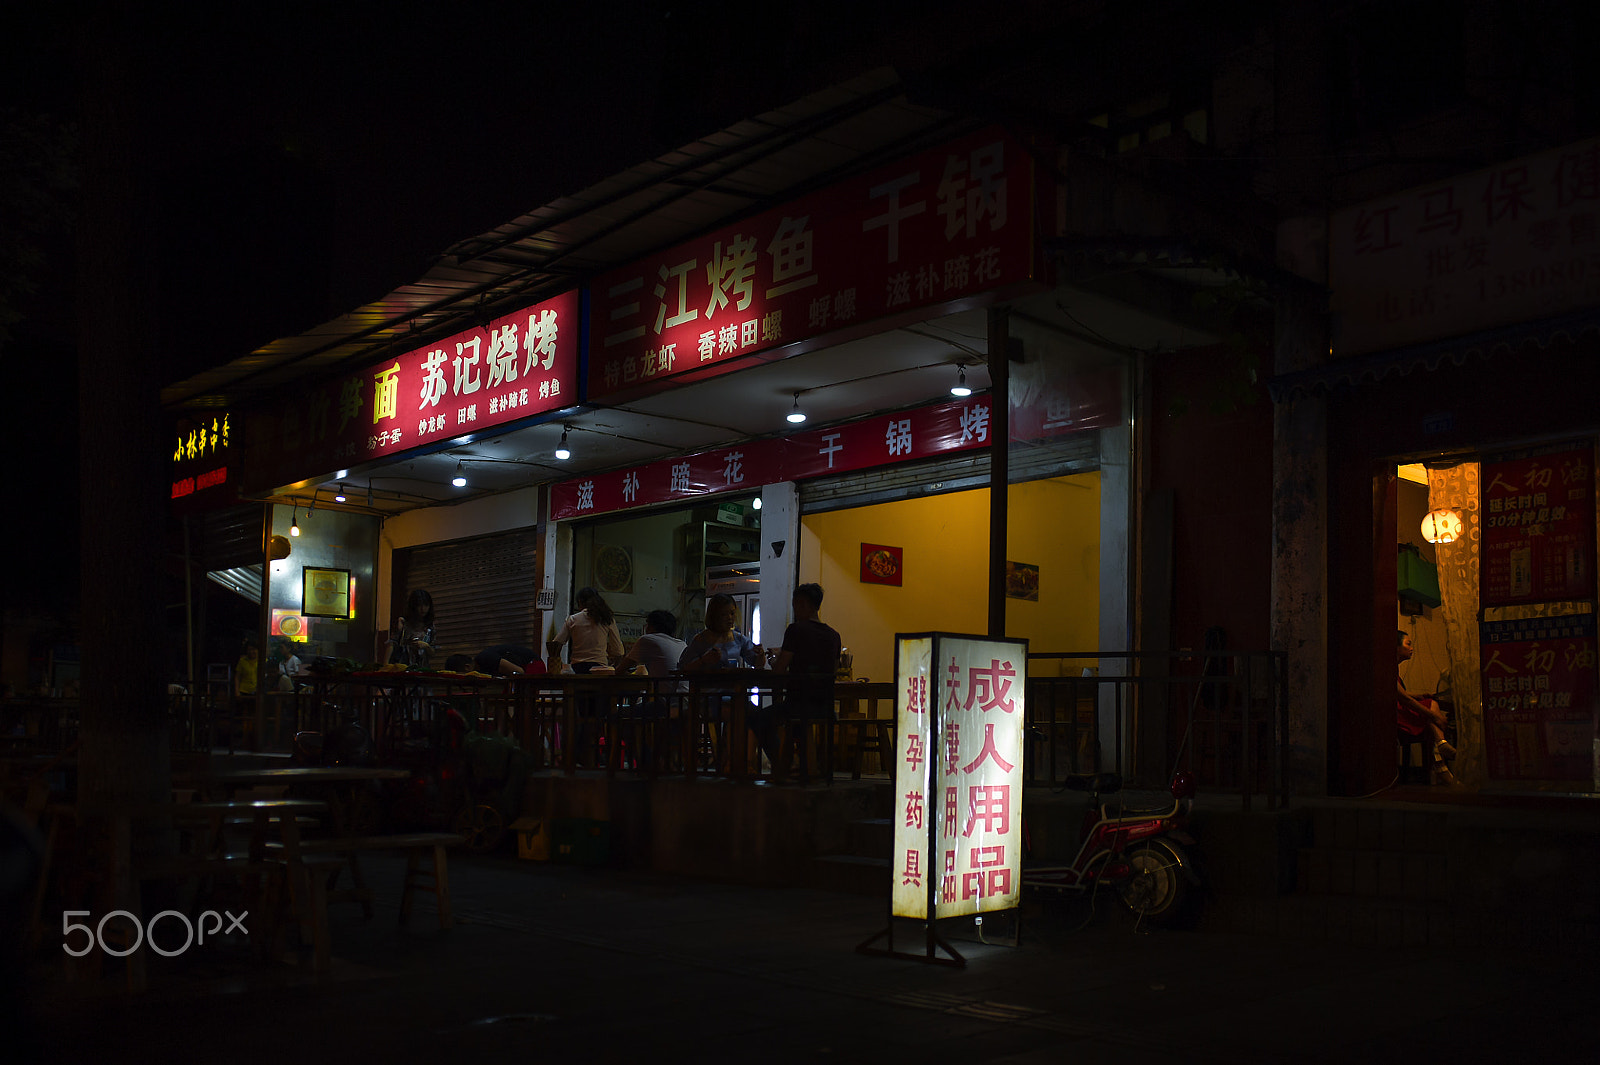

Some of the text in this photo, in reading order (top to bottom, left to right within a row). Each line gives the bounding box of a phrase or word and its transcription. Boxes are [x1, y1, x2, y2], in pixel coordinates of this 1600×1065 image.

[604, 140, 1008, 347] 三江烤鱼 干锅
[604, 343, 677, 388] 特色龙虾
[698, 310, 782, 362] 香辣田螺
[886, 246, 1001, 308] 滋补蹄花
[418, 413, 446, 436] 炒龙虾
[457, 404, 477, 425] 田螺
[489, 388, 529, 415] 滋补蹄花
[539, 377, 561, 400] 烤鱼
[419, 310, 558, 410] 苏记烧烤
[577, 452, 744, 511] 滋补蹄花
[902, 675, 927, 888] 避孕药具
[942, 656, 961, 904] 夫妻用品
[962, 658, 1016, 900] 成人用品
